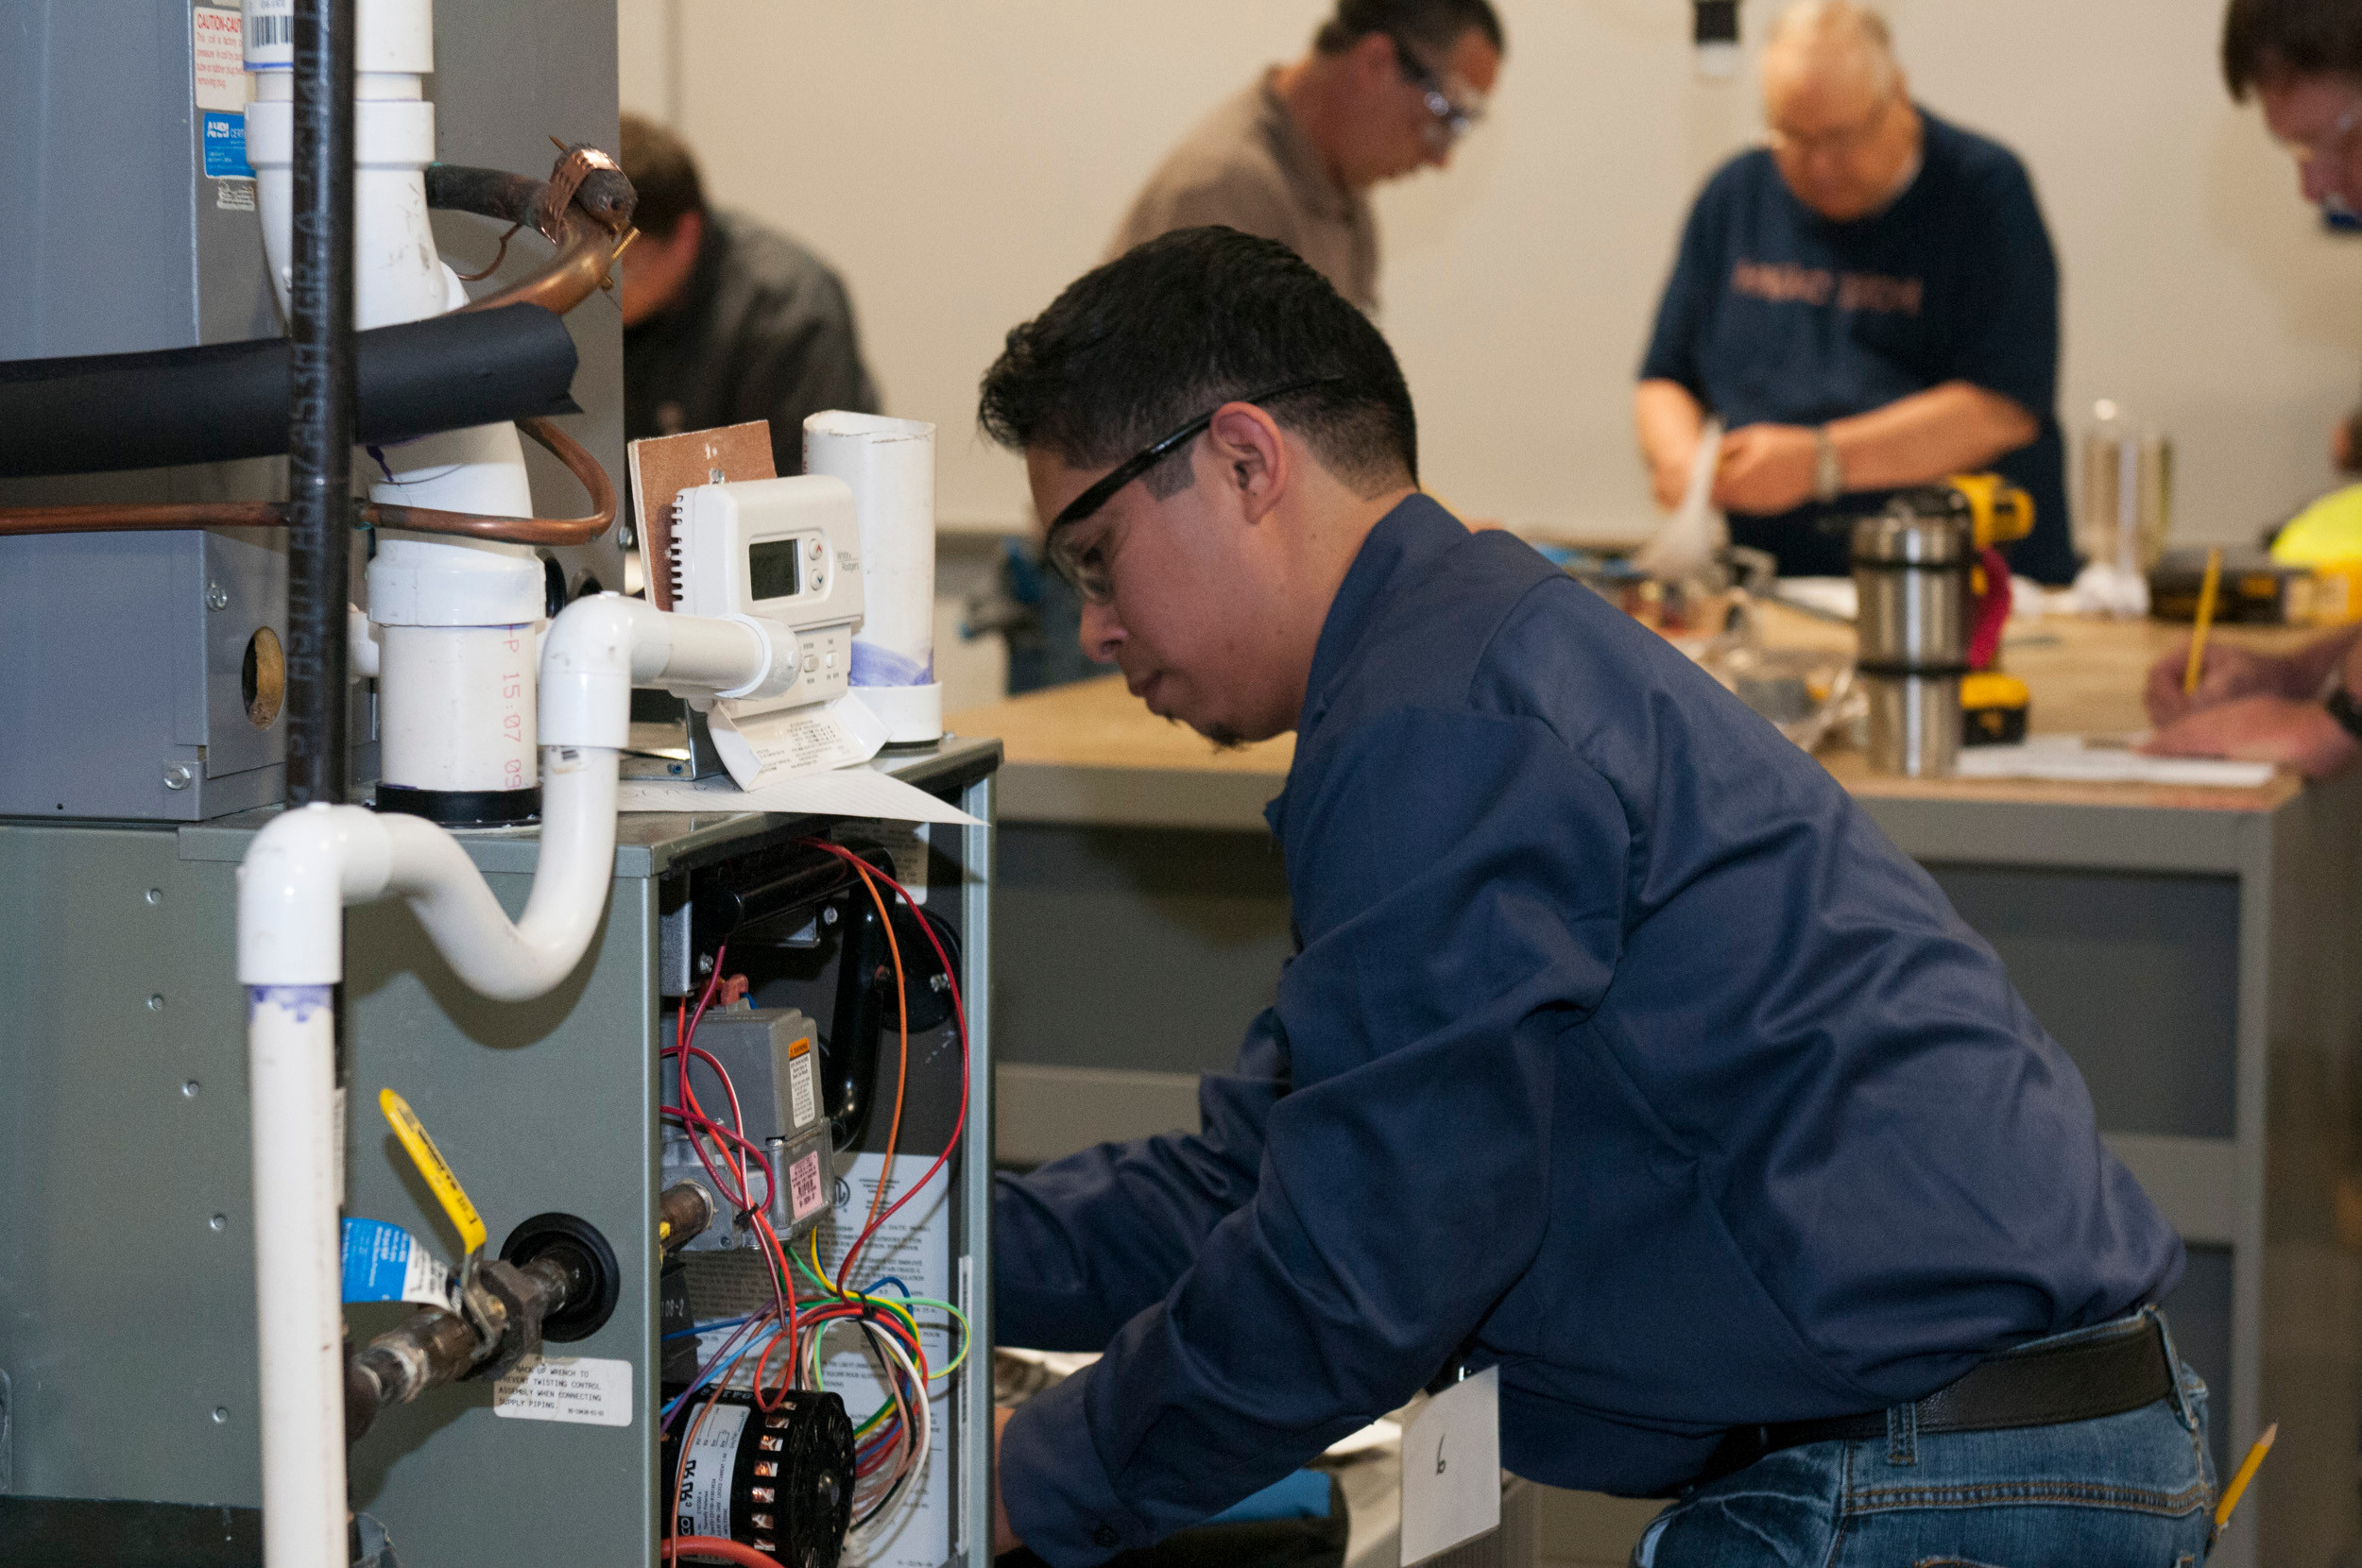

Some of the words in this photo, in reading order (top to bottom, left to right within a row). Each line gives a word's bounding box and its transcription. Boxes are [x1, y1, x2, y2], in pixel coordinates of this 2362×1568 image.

[502, 672, 522, 742] 15:07
[550, 1369, 576, 1377] WRENCH
[533, 1379, 568, 1388] TWISTING
[571, 1382, 602, 1390] CONTROL
[537, 1389, 556, 1398] WHEN
[558, 1392, 602, 1402] CONNECTING
